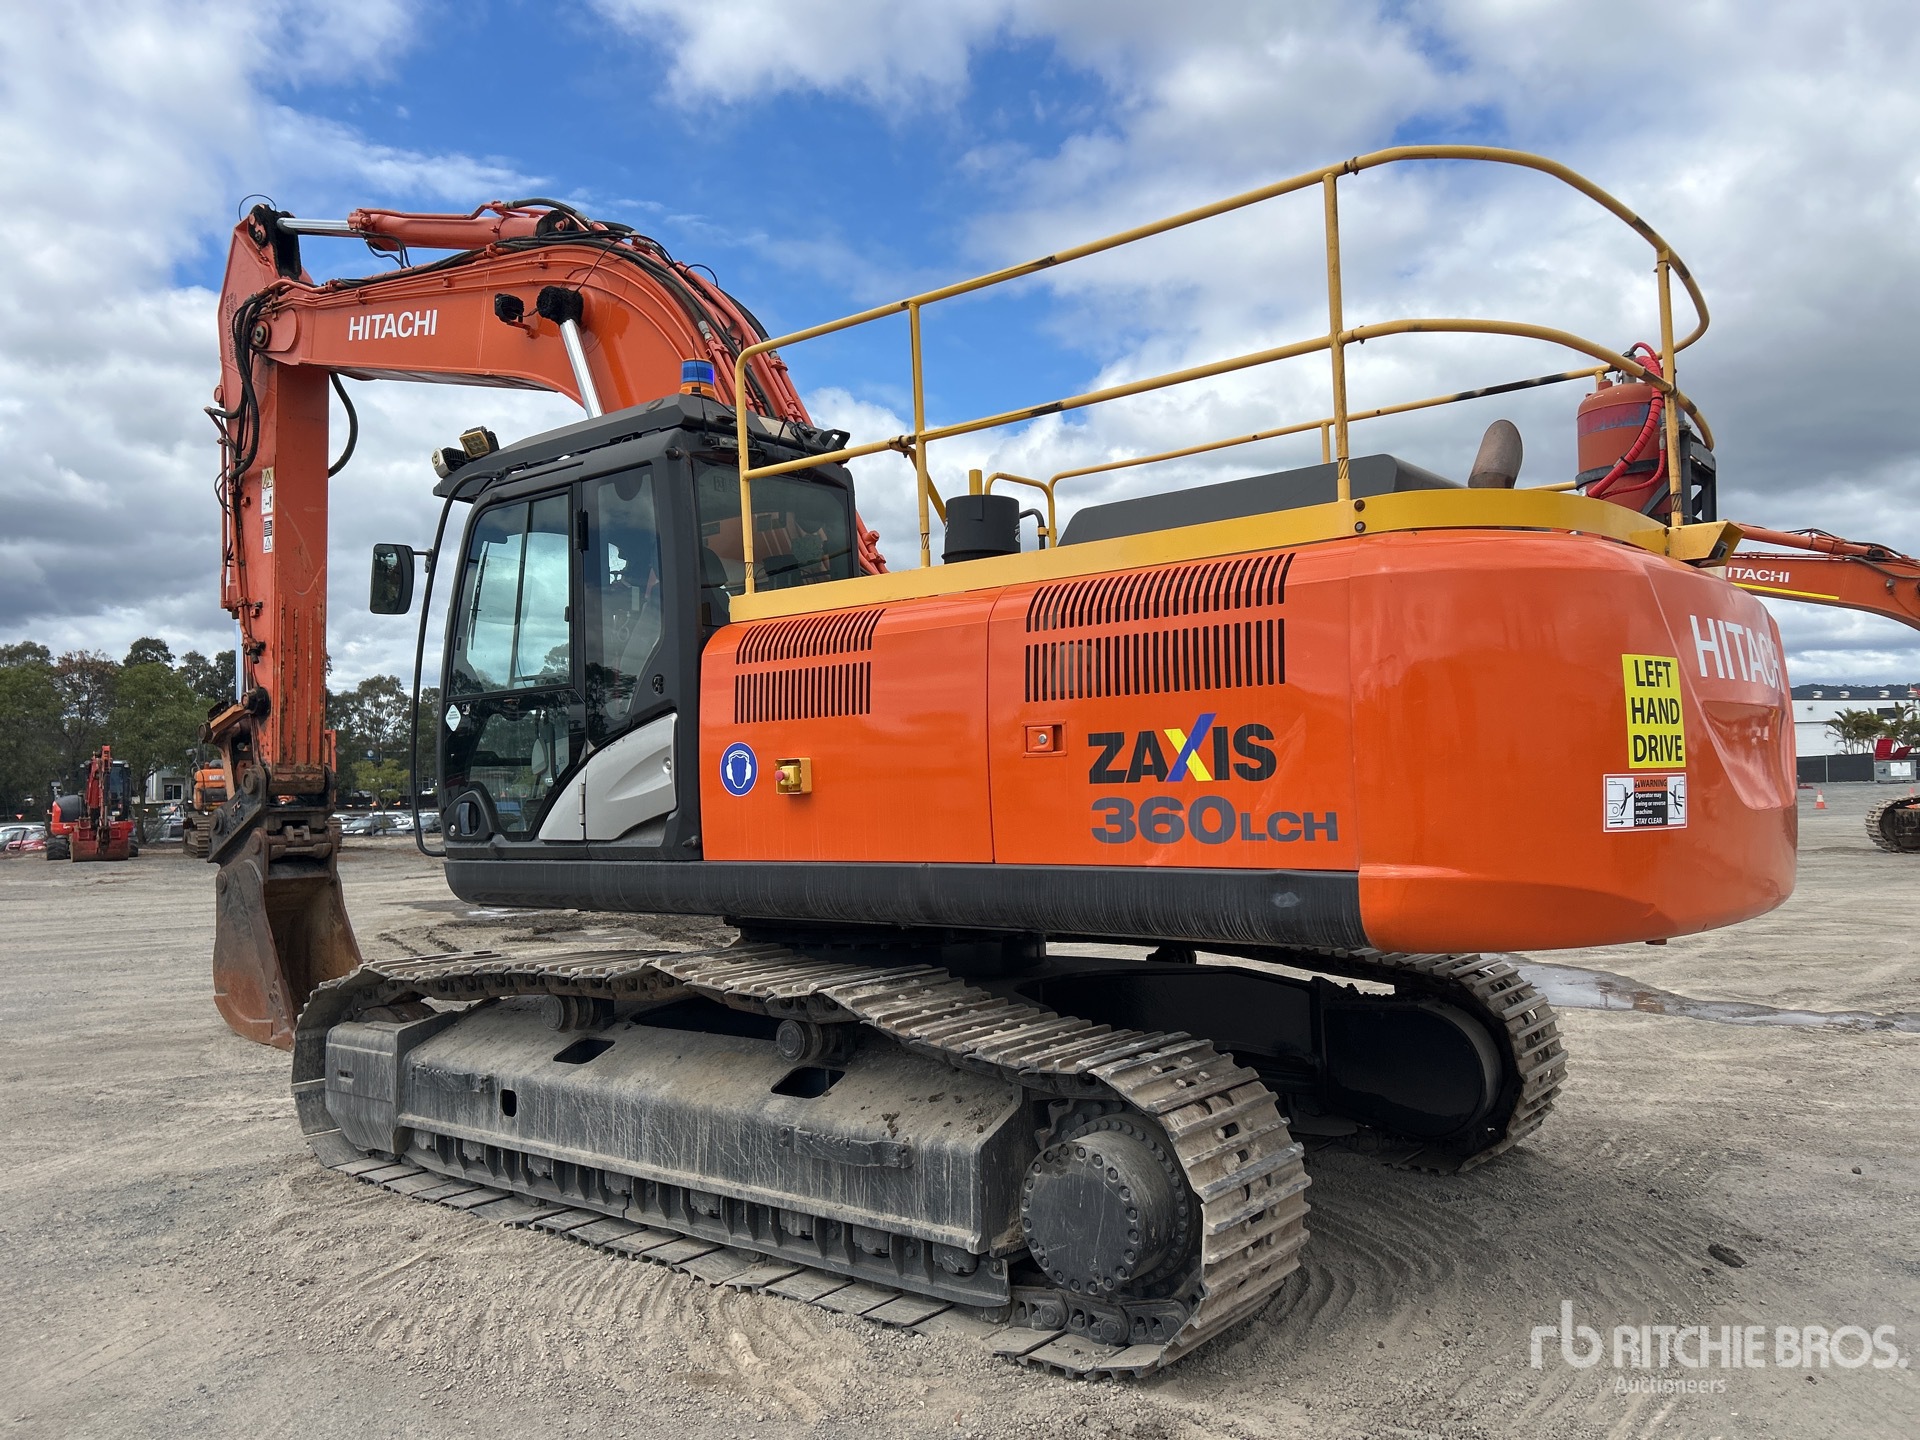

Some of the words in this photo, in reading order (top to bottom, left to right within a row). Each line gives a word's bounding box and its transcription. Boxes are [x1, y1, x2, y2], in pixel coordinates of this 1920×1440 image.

[348, 309, 438, 341] HITACHI
[1727, 566, 1790, 583] ITACHI
[1689, 614, 1785, 694] HITACH
[1634, 660, 1671, 688] LEFT
[1631, 697, 1680, 725] HAND
[1088, 713, 1277, 784] ZAXIS
[1633, 735, 1683, 762] DRIVE
[1640, 779, 1667, 787] WARNING
[1091, 795, 1339, 845] 360LCH
